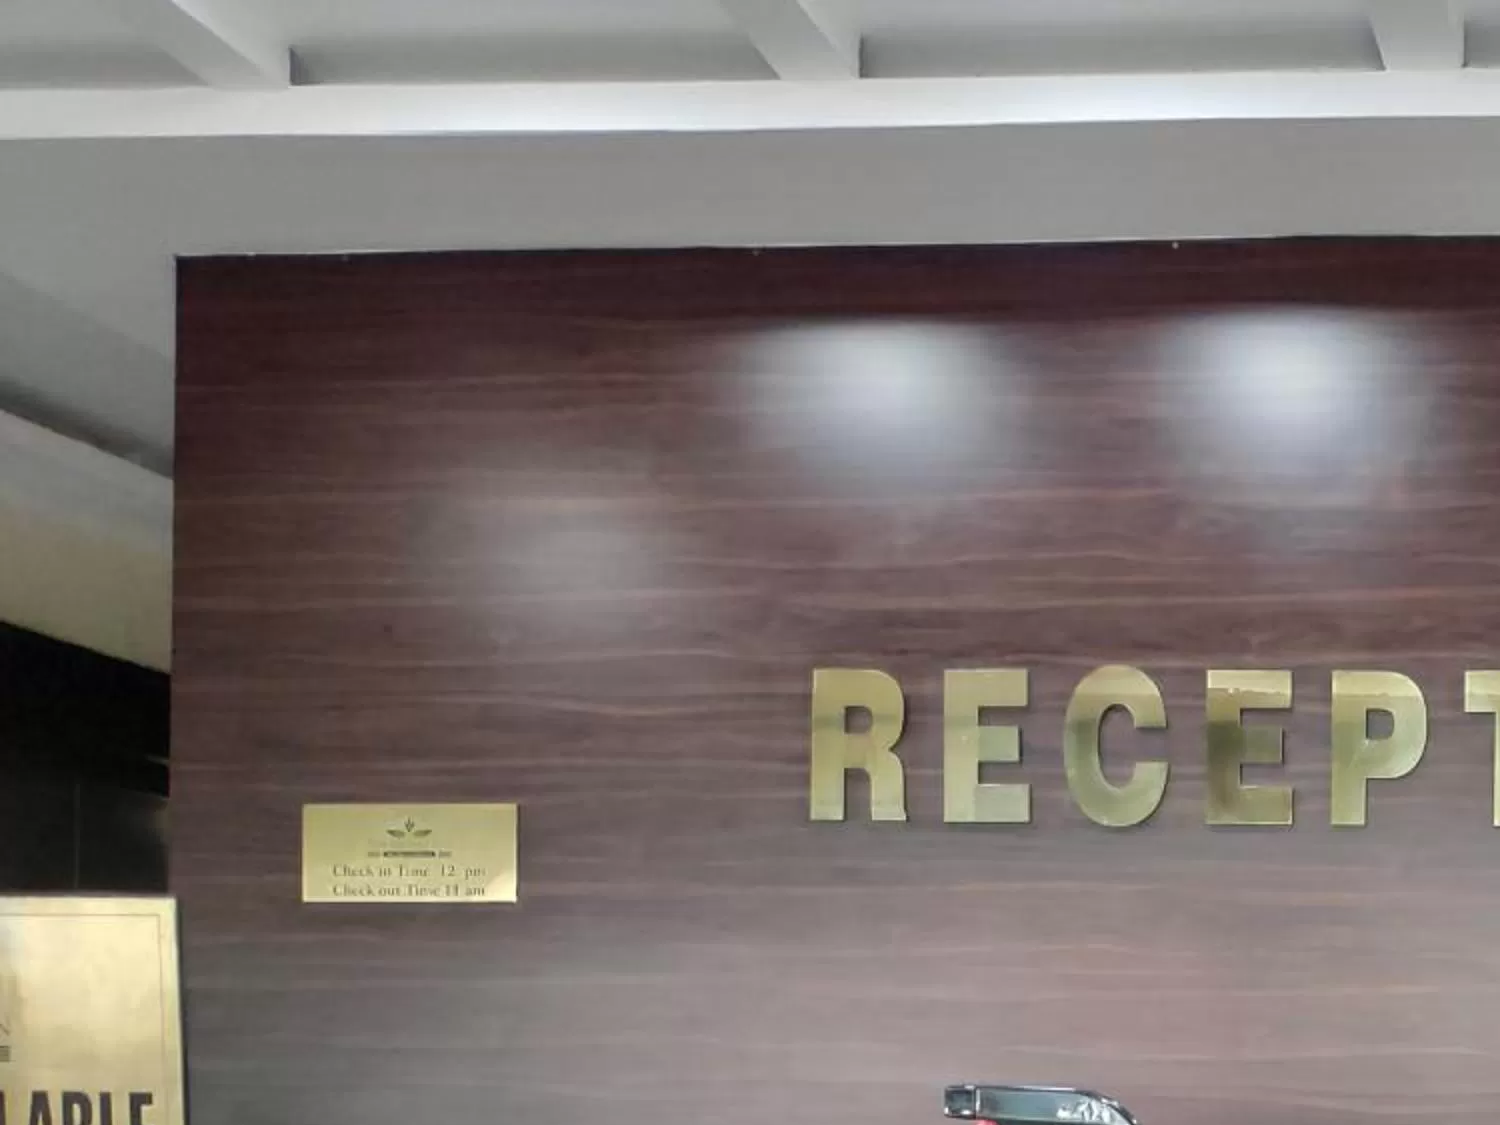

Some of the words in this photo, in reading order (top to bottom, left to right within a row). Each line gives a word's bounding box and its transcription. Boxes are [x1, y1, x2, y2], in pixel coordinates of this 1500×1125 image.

[332, 864, 374, 877] Check
[440, 865, 455, 877] 12
[332, 884, 374, 896] Check
[465, 887, 485, 896] am
